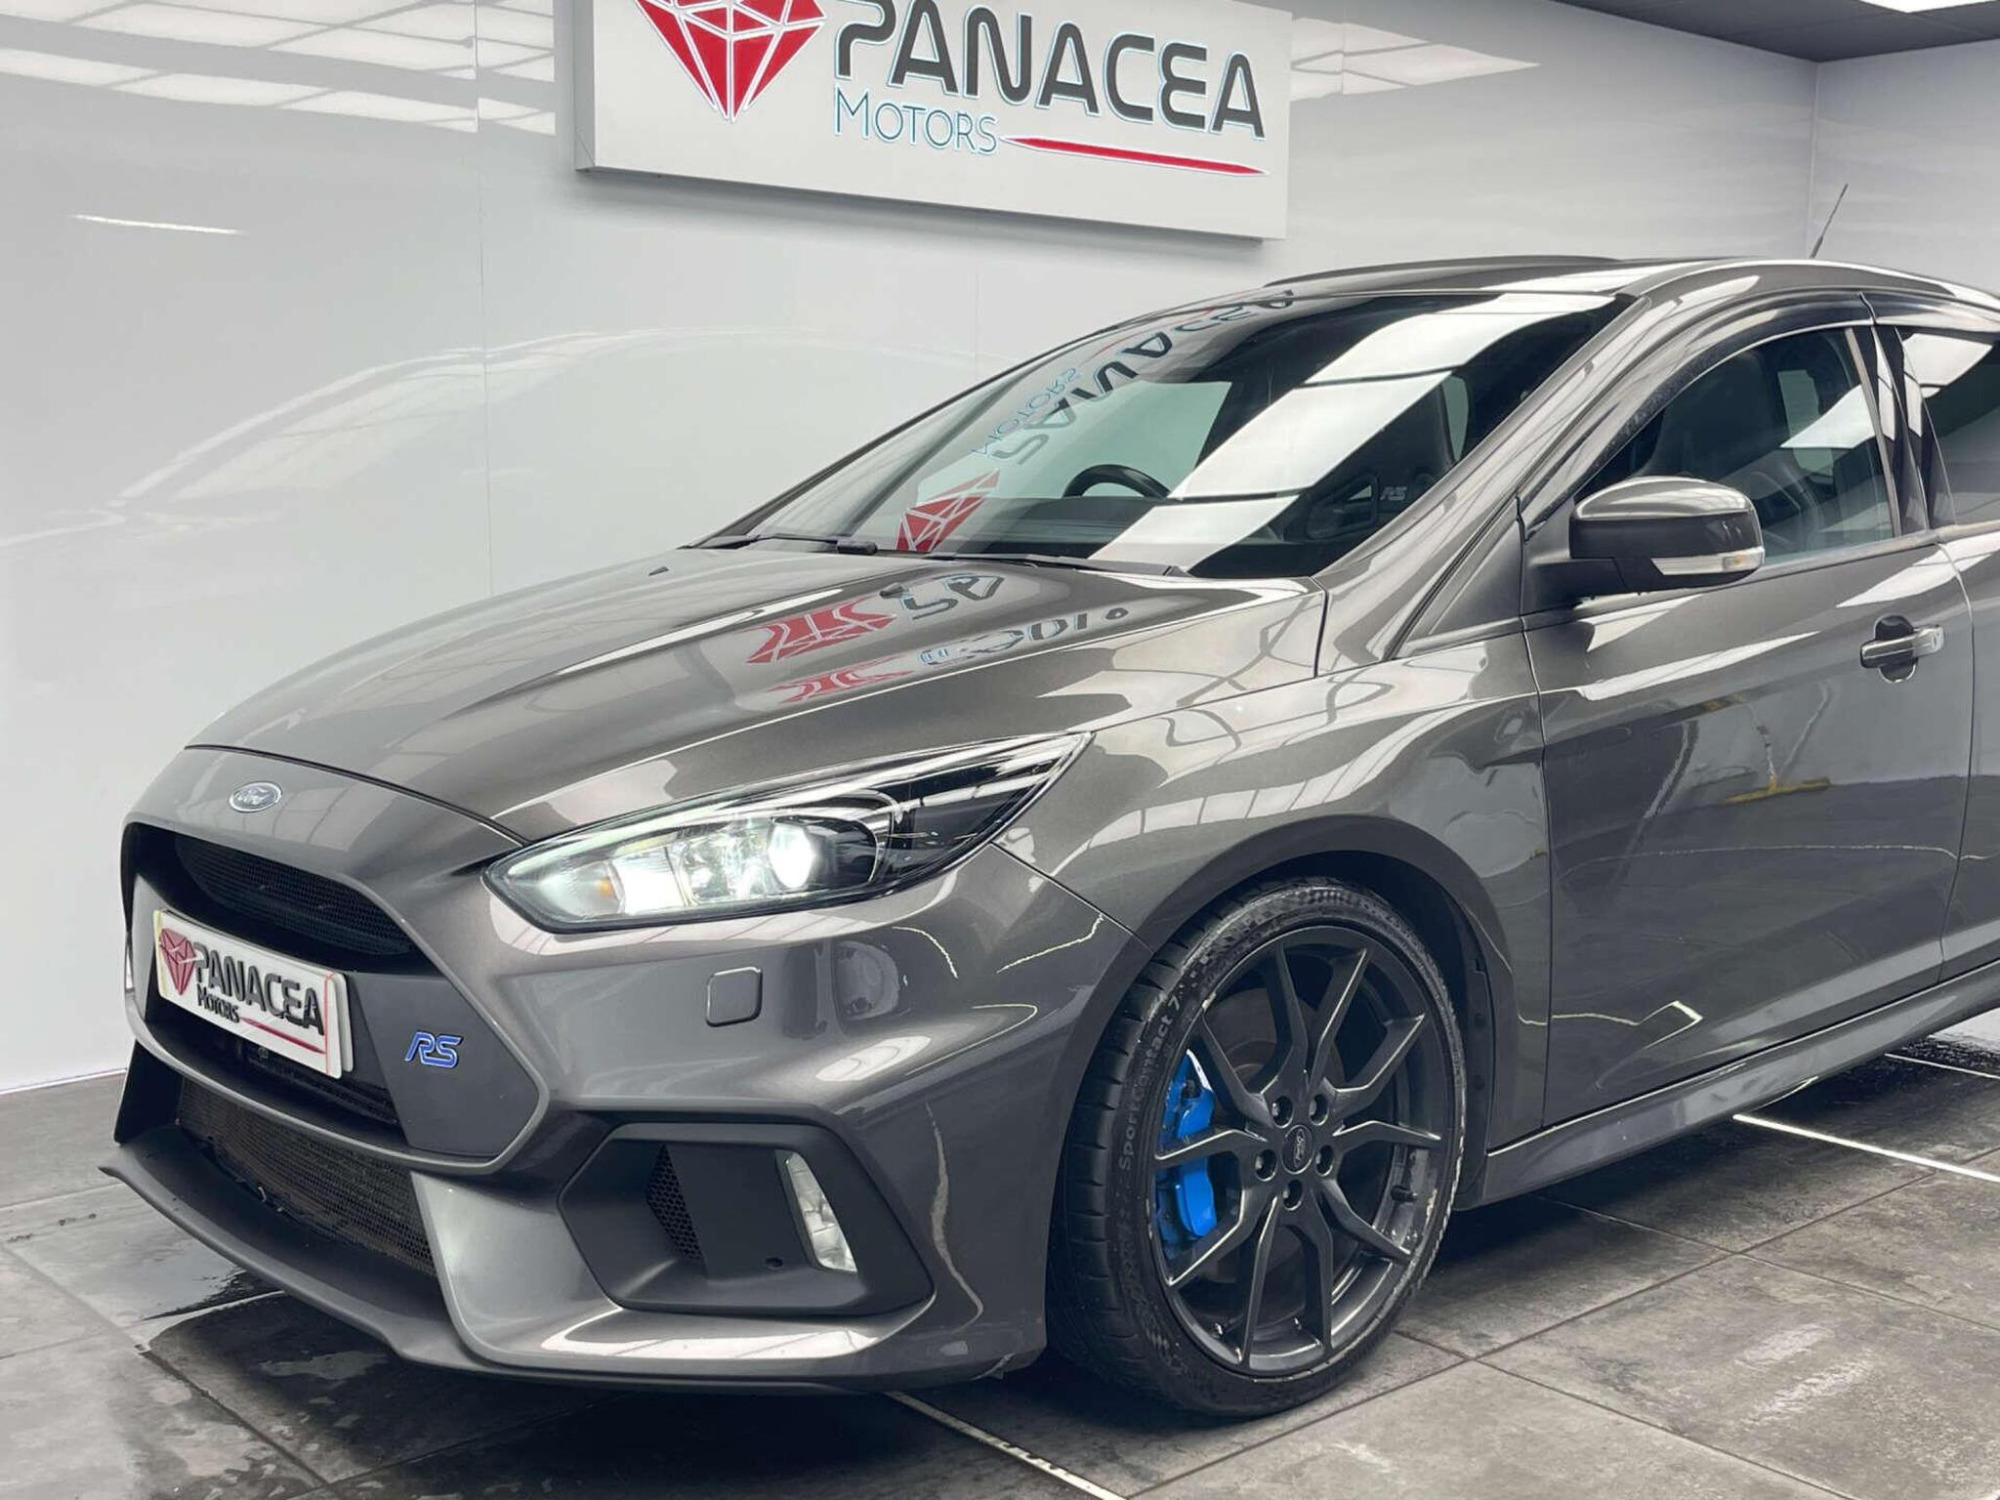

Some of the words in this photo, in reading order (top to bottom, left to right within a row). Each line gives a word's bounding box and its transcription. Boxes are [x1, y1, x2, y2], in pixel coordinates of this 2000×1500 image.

[835, 0, 1266, 139] PANACEA
[194, 941, 325, 1036] PANACEA
[405, 1031, 463, 1068] RS
